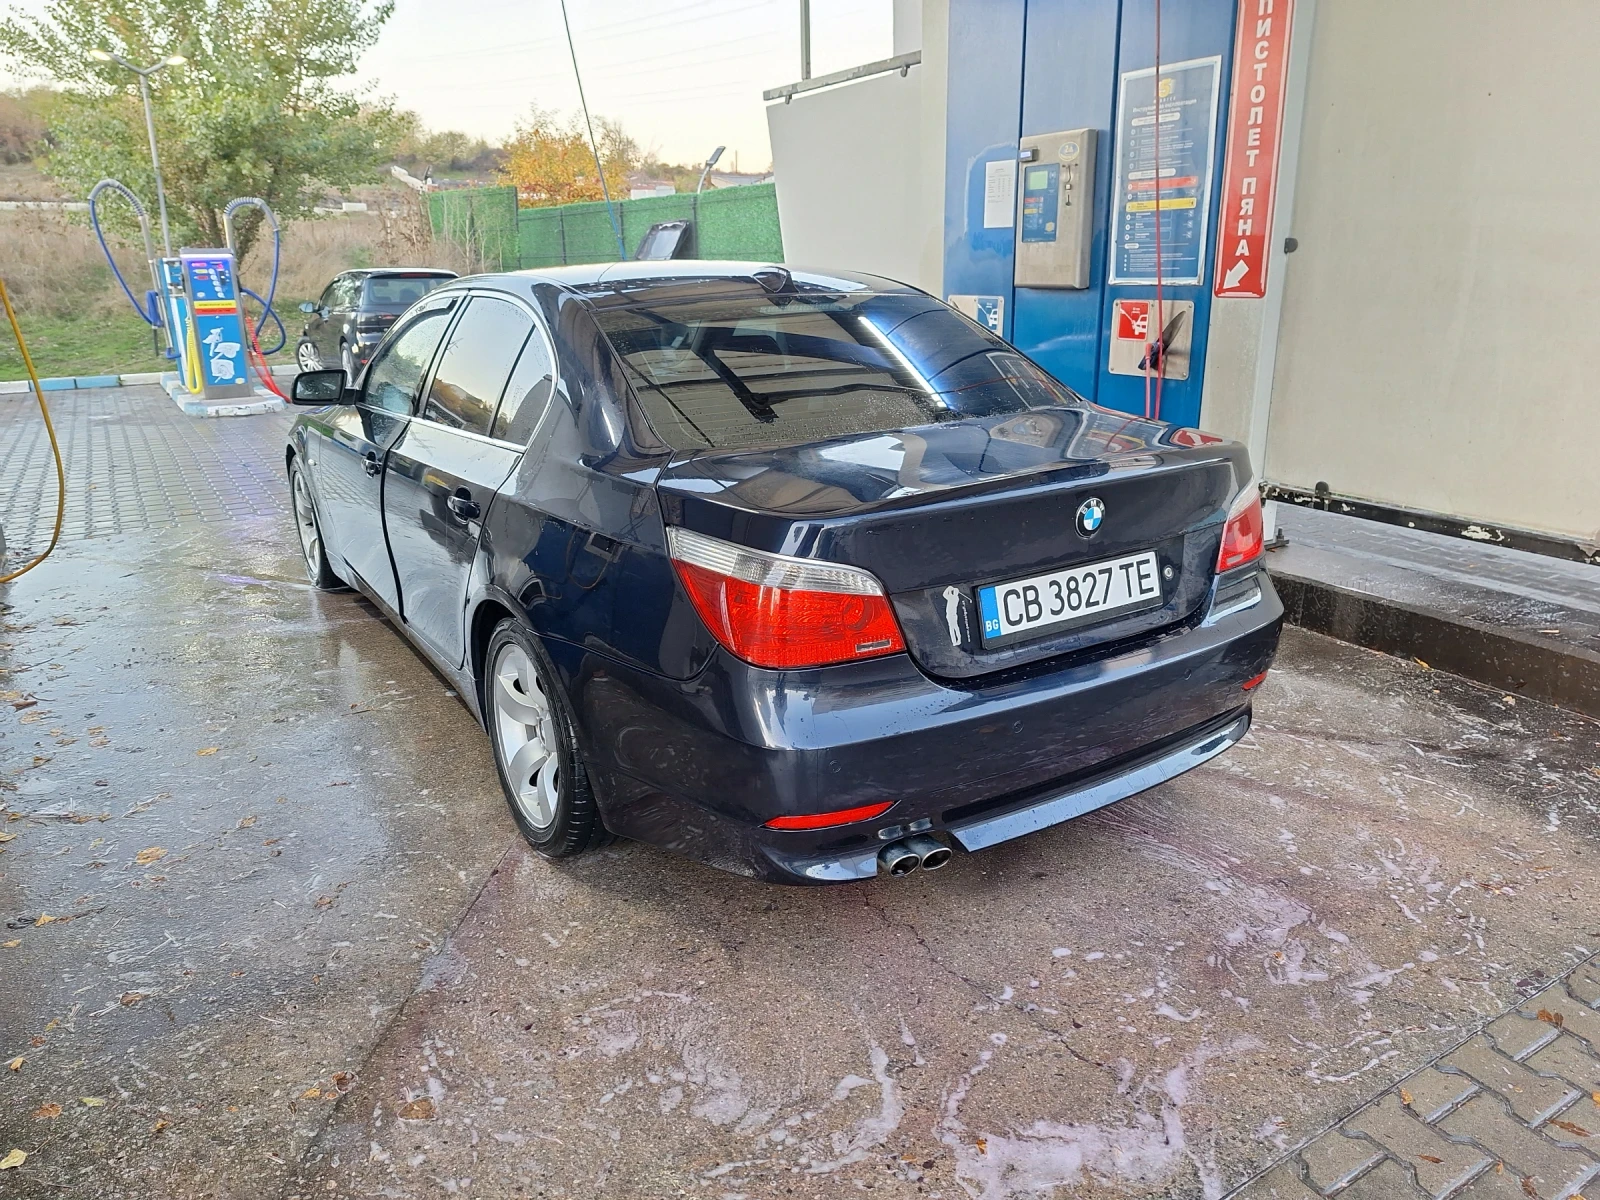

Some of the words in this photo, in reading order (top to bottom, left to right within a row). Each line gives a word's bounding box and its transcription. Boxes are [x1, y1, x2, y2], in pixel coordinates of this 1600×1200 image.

[1246, 0, 1274, 167] ПИСТОЛЕТ
[1235, 177, 1257, 257] ПЯНА
[1080, 499, 1105, 515] BMW
[985, 618, 999, 632] BG
[1003, 584, 1043, 626] CB
[1049, 567, 1113, 616] 3827
[1119, 558, 1155, 598] TE
